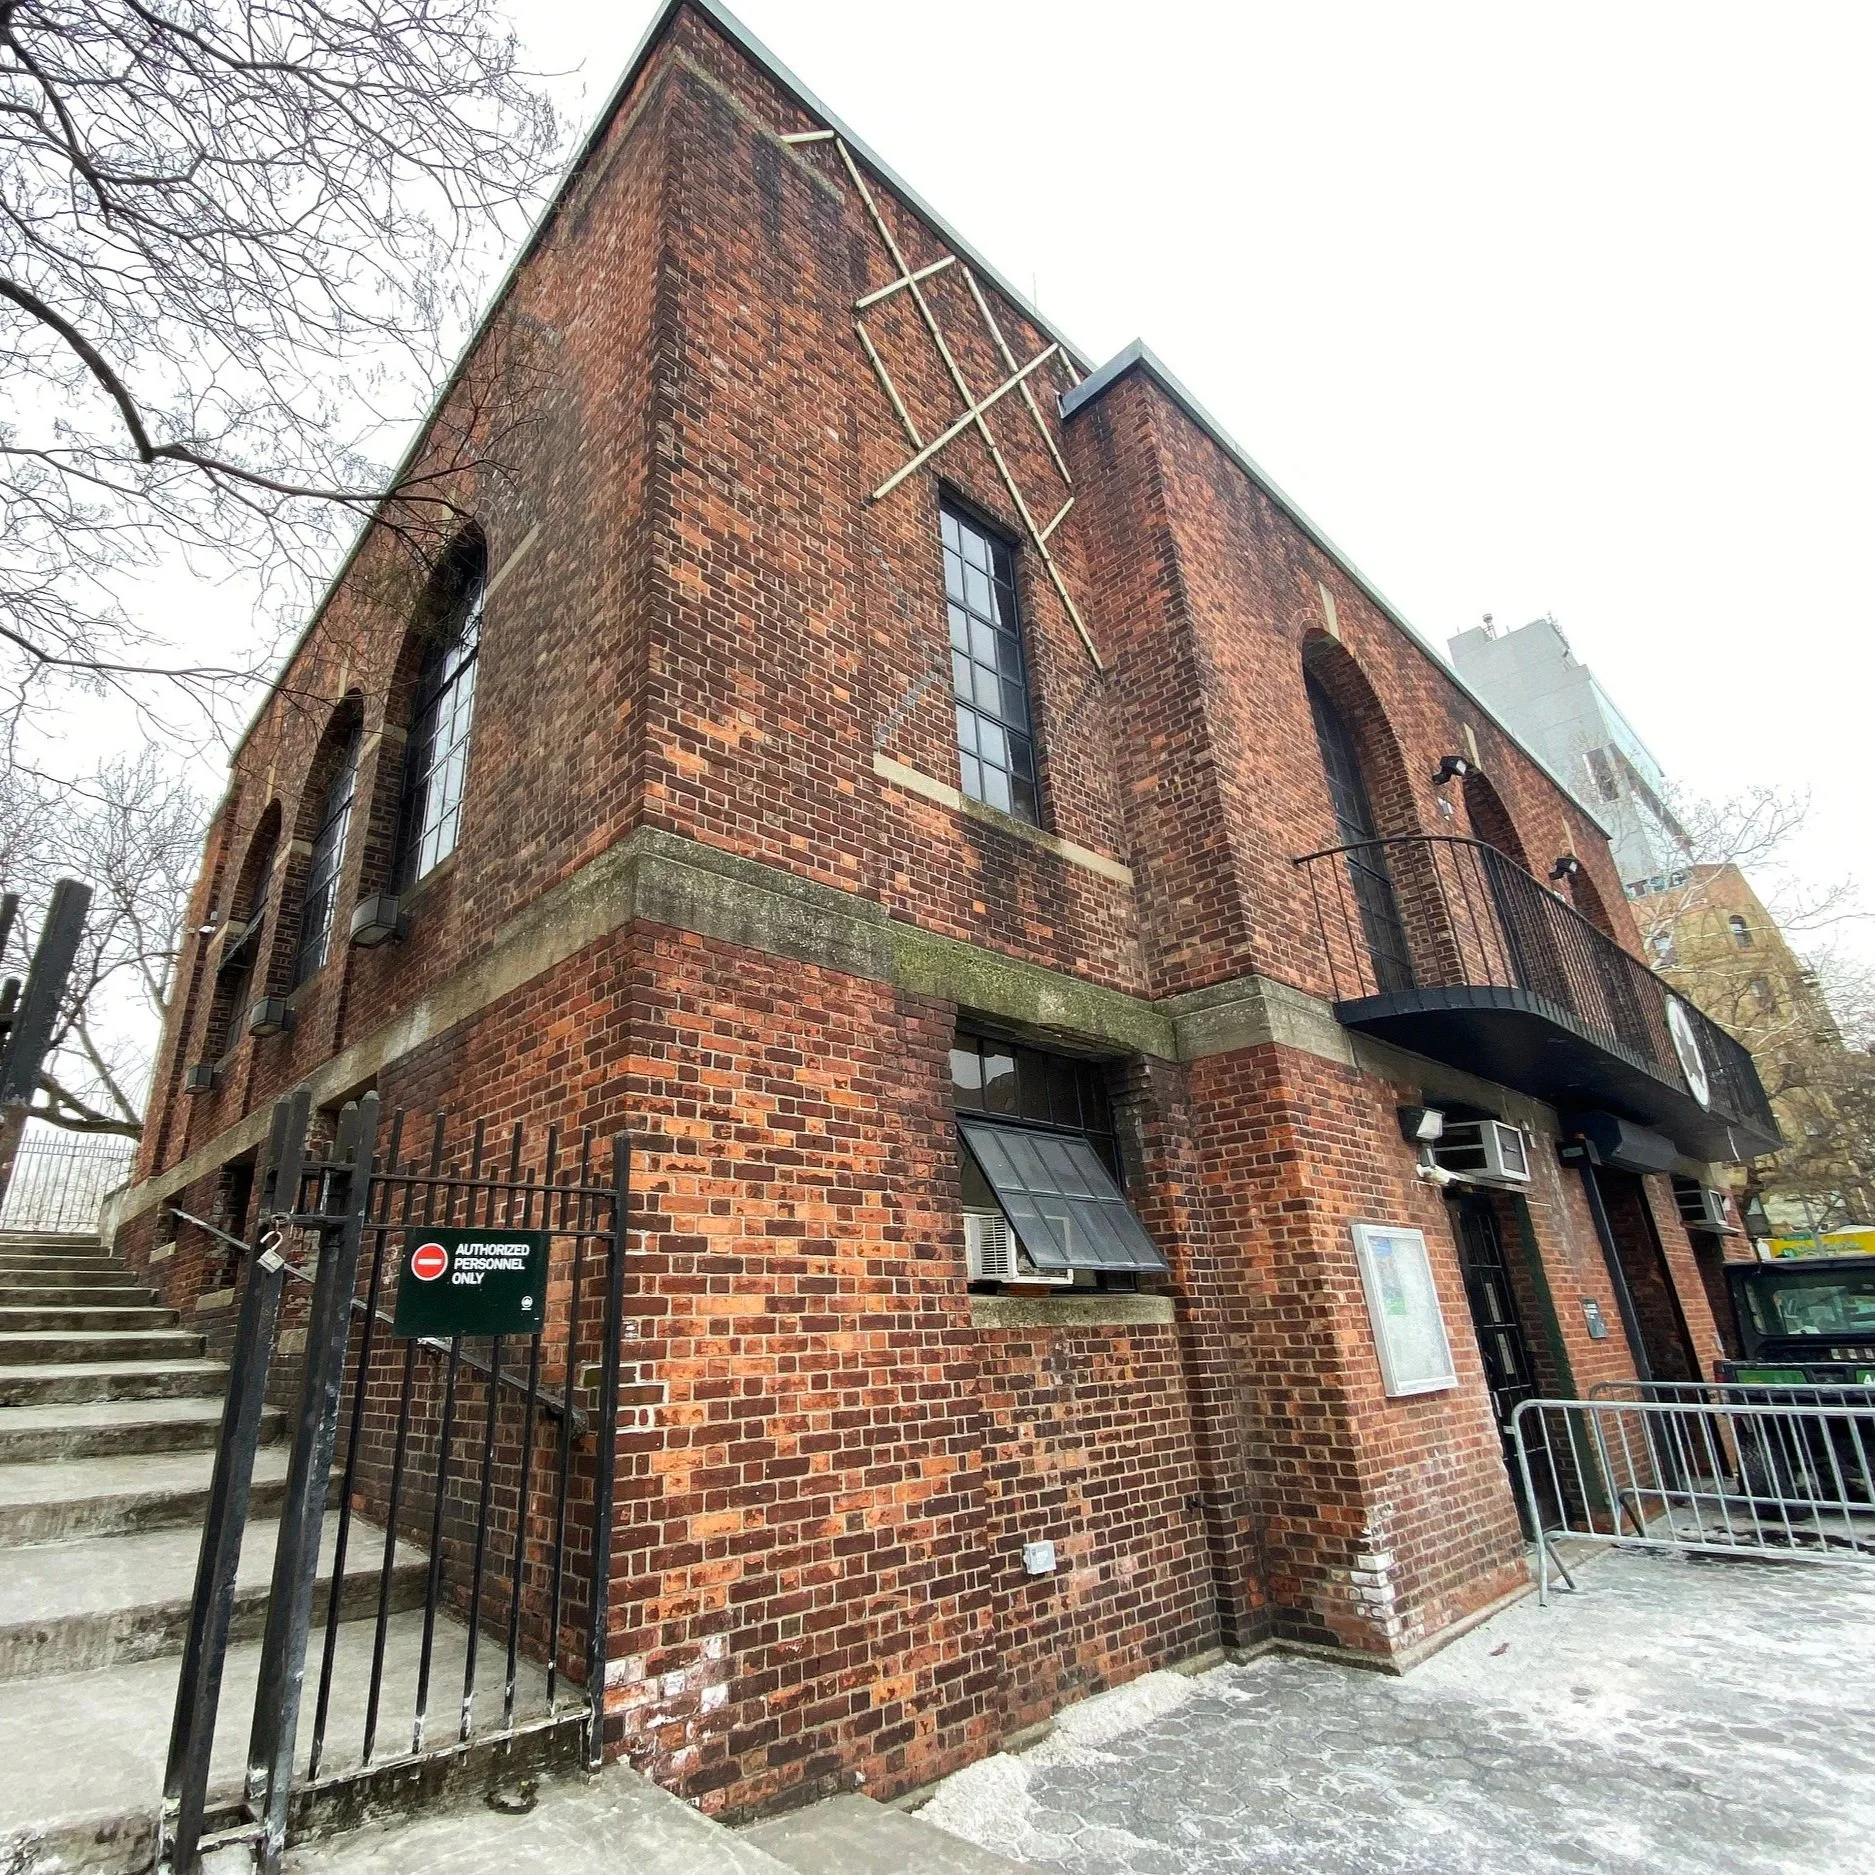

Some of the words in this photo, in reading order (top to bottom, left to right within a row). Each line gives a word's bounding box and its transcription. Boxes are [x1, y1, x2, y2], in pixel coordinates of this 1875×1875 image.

[455, 1244, 530, 1256] AUTHORIZED
[454, 1258, 525, 1270] PERSONNEL
[452, 1272, 484, 1284] ONLY
